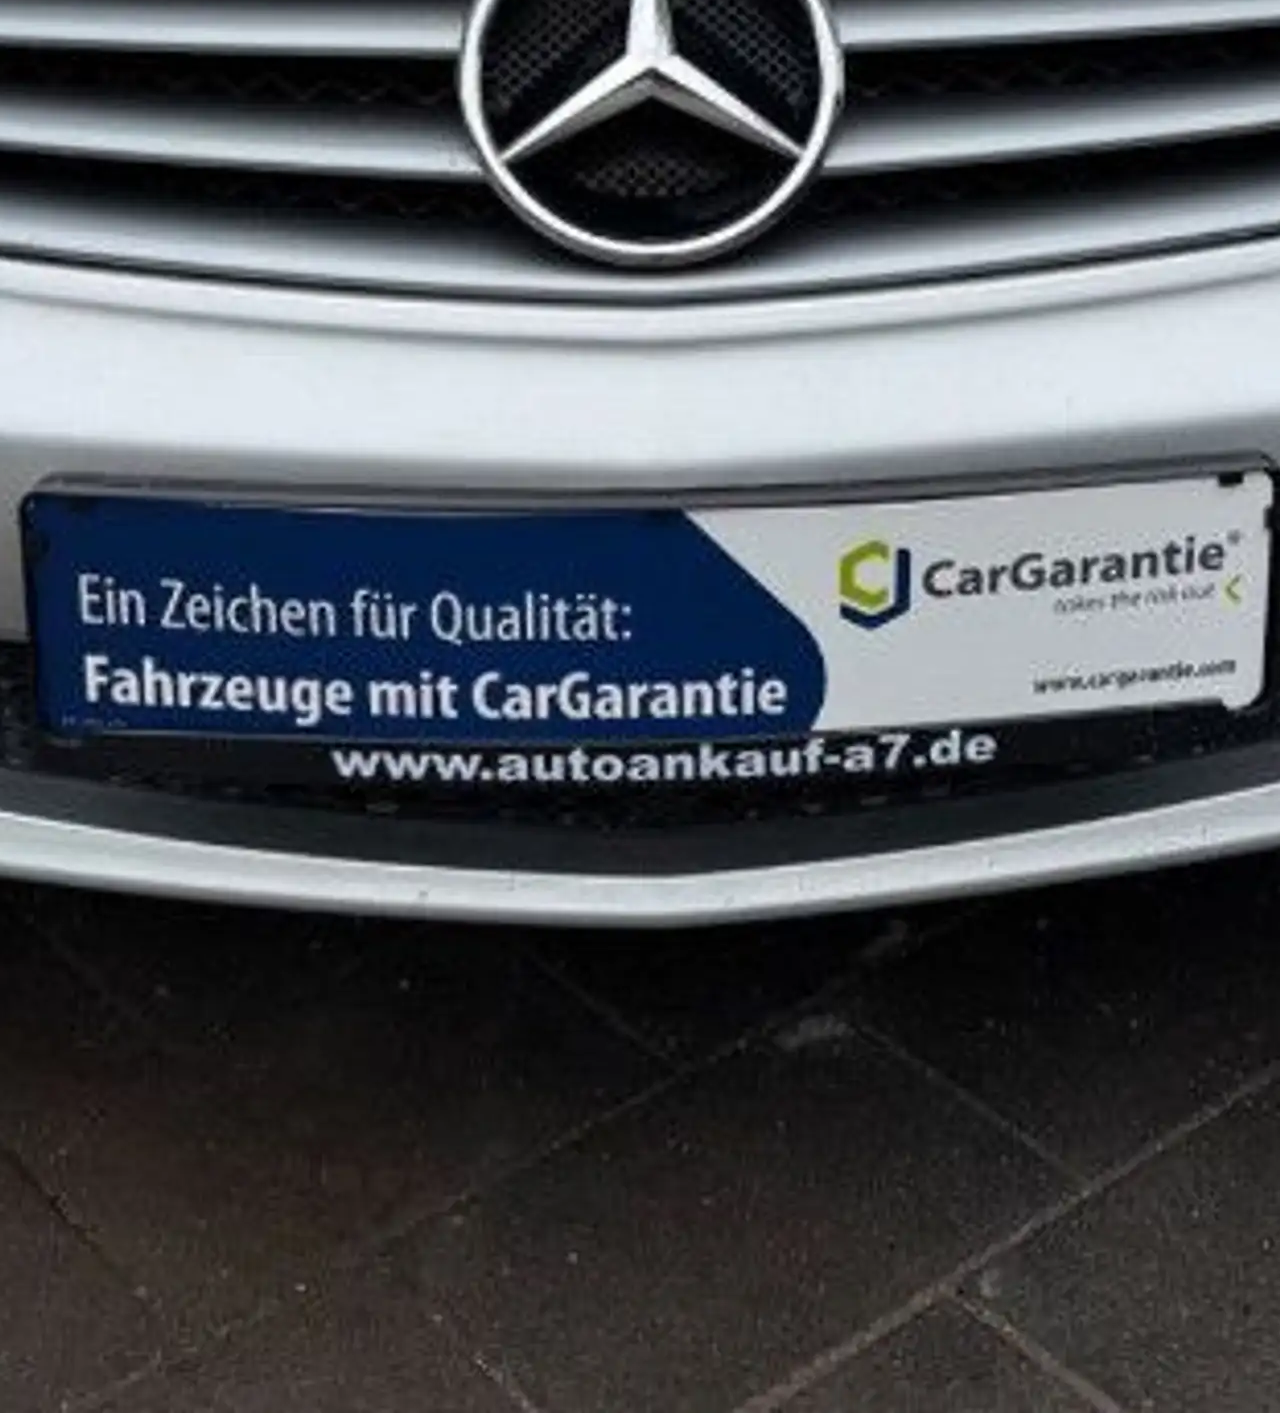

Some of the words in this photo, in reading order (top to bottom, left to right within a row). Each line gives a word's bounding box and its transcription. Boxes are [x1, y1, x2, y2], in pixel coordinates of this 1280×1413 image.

[77, 572, 146, 627] Ein
[159, 577, 337, 638] Zeichen
[350, 588, 419, 641] für
[430, 589, 633, 646] Qualität:
[83, 653, 354, 728] Fahrzeuge
[369, 669, 459, 719] mit
[471, 666, 788, 720] CarGarantie
[331, 728, 998, 782] www.autoankauf-a7.de
